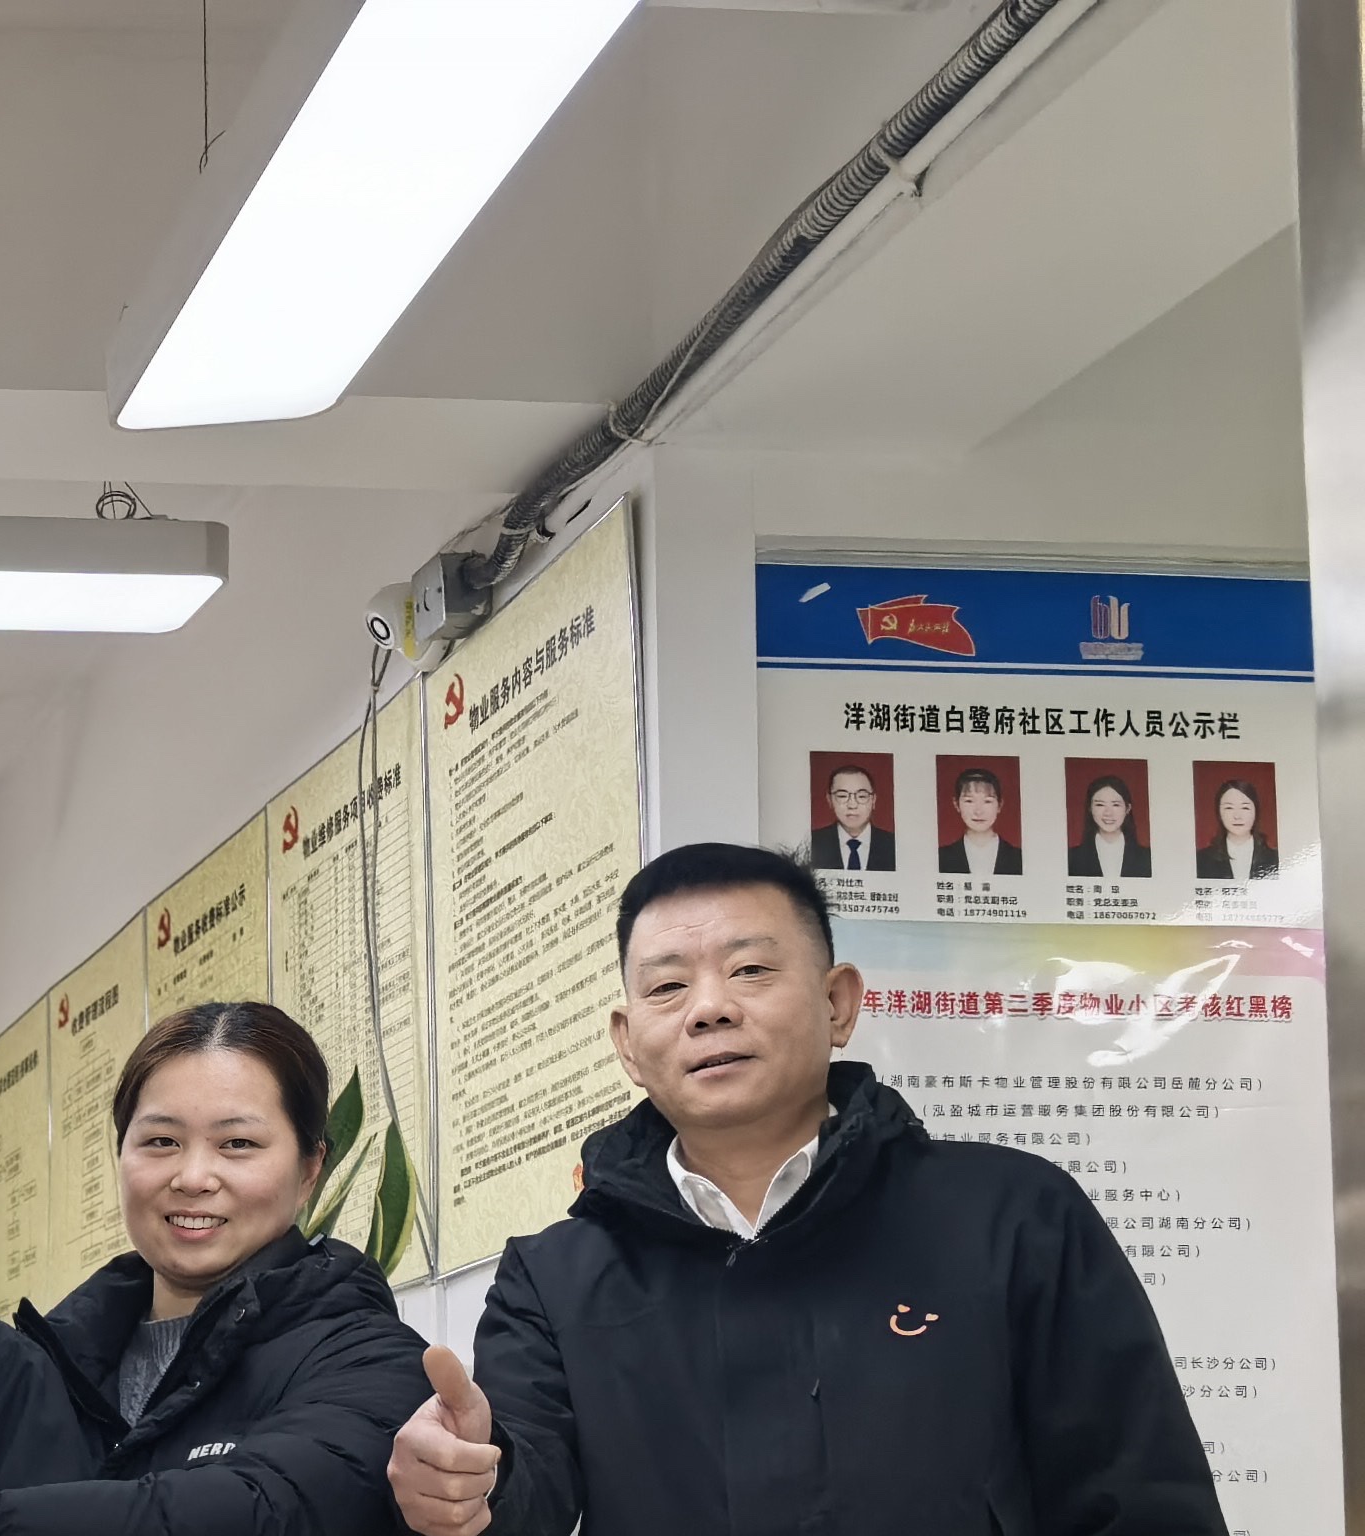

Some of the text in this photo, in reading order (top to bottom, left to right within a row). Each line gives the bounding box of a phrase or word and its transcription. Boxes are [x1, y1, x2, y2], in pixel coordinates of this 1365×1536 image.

[469, 605, 596, 734] 物业服务内容与服务标准
[844, 702, 1241, 740] 洋湖街道白鹭府社区工作人员公示栏
[862, 990, 1294, 1021] 年洋湖街道第二季度物业小区考核红黑榜
